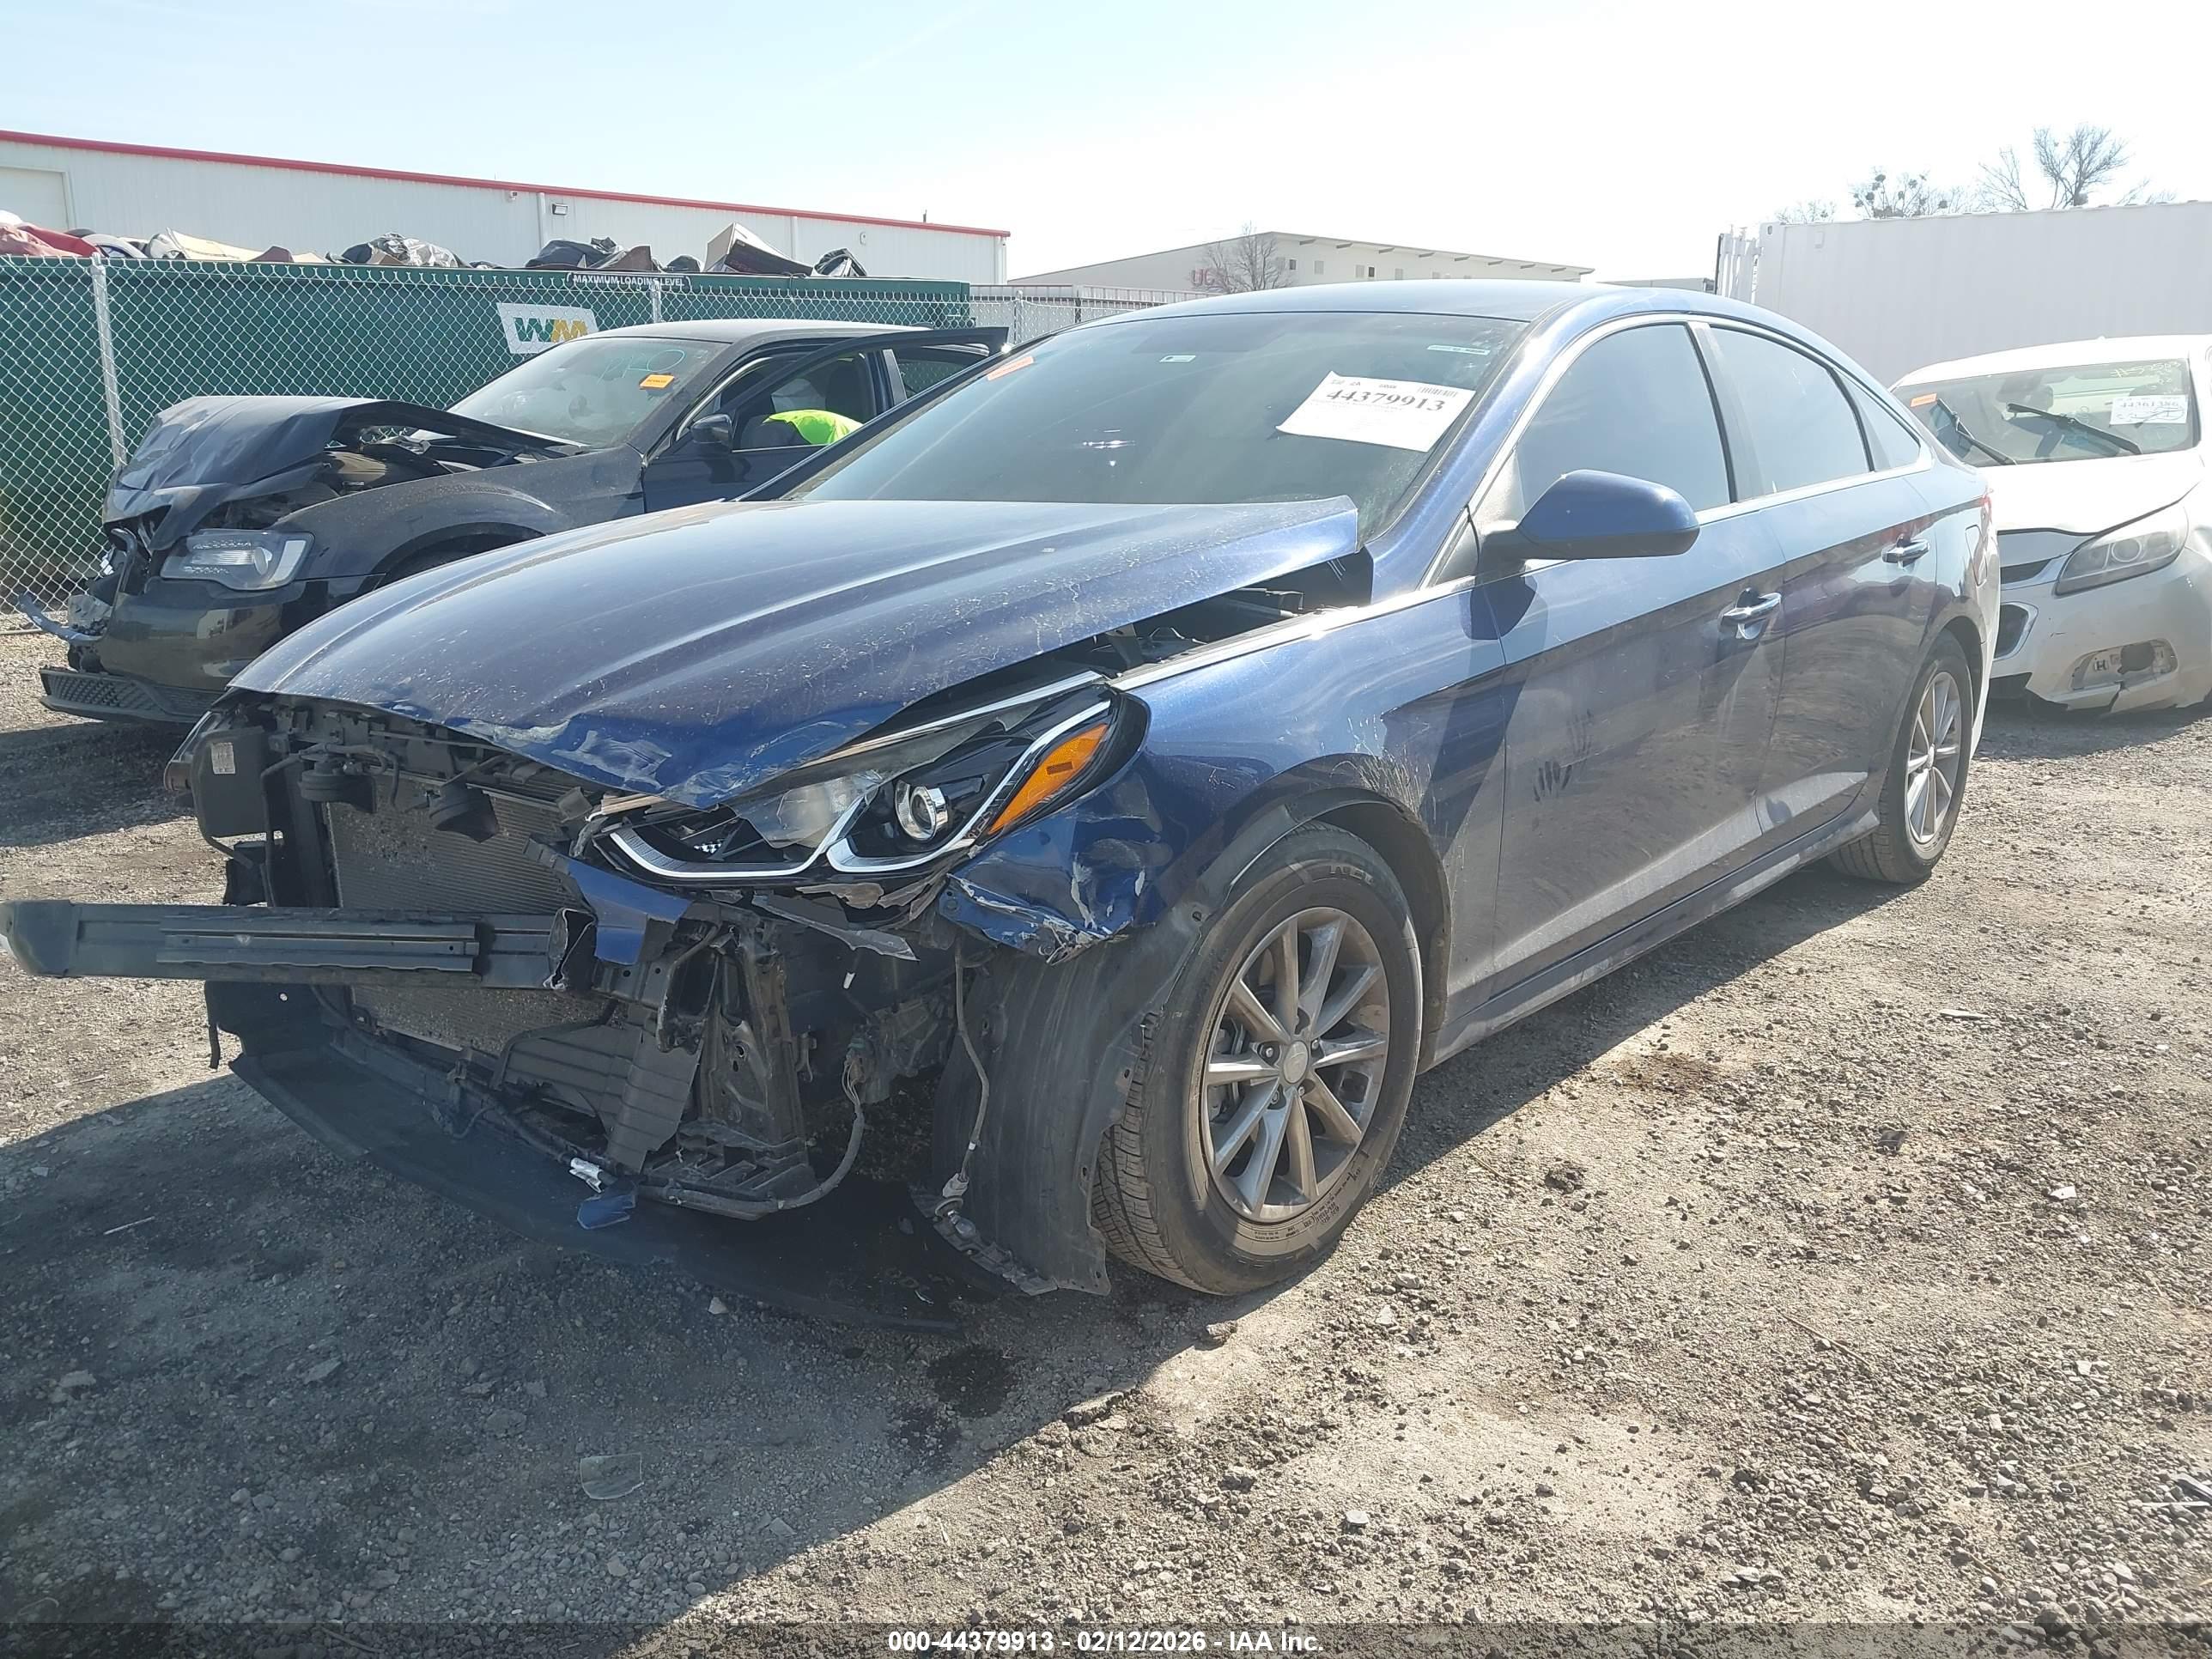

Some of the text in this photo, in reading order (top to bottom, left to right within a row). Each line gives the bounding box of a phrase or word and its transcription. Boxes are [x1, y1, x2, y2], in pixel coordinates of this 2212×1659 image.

[574, 274, 617, 284] MAXIMUM
[660, 277, 684, 287] LEVEL
[514, 317, 588, 343] WM
[1327, 389, 1446, 412] 44379913
